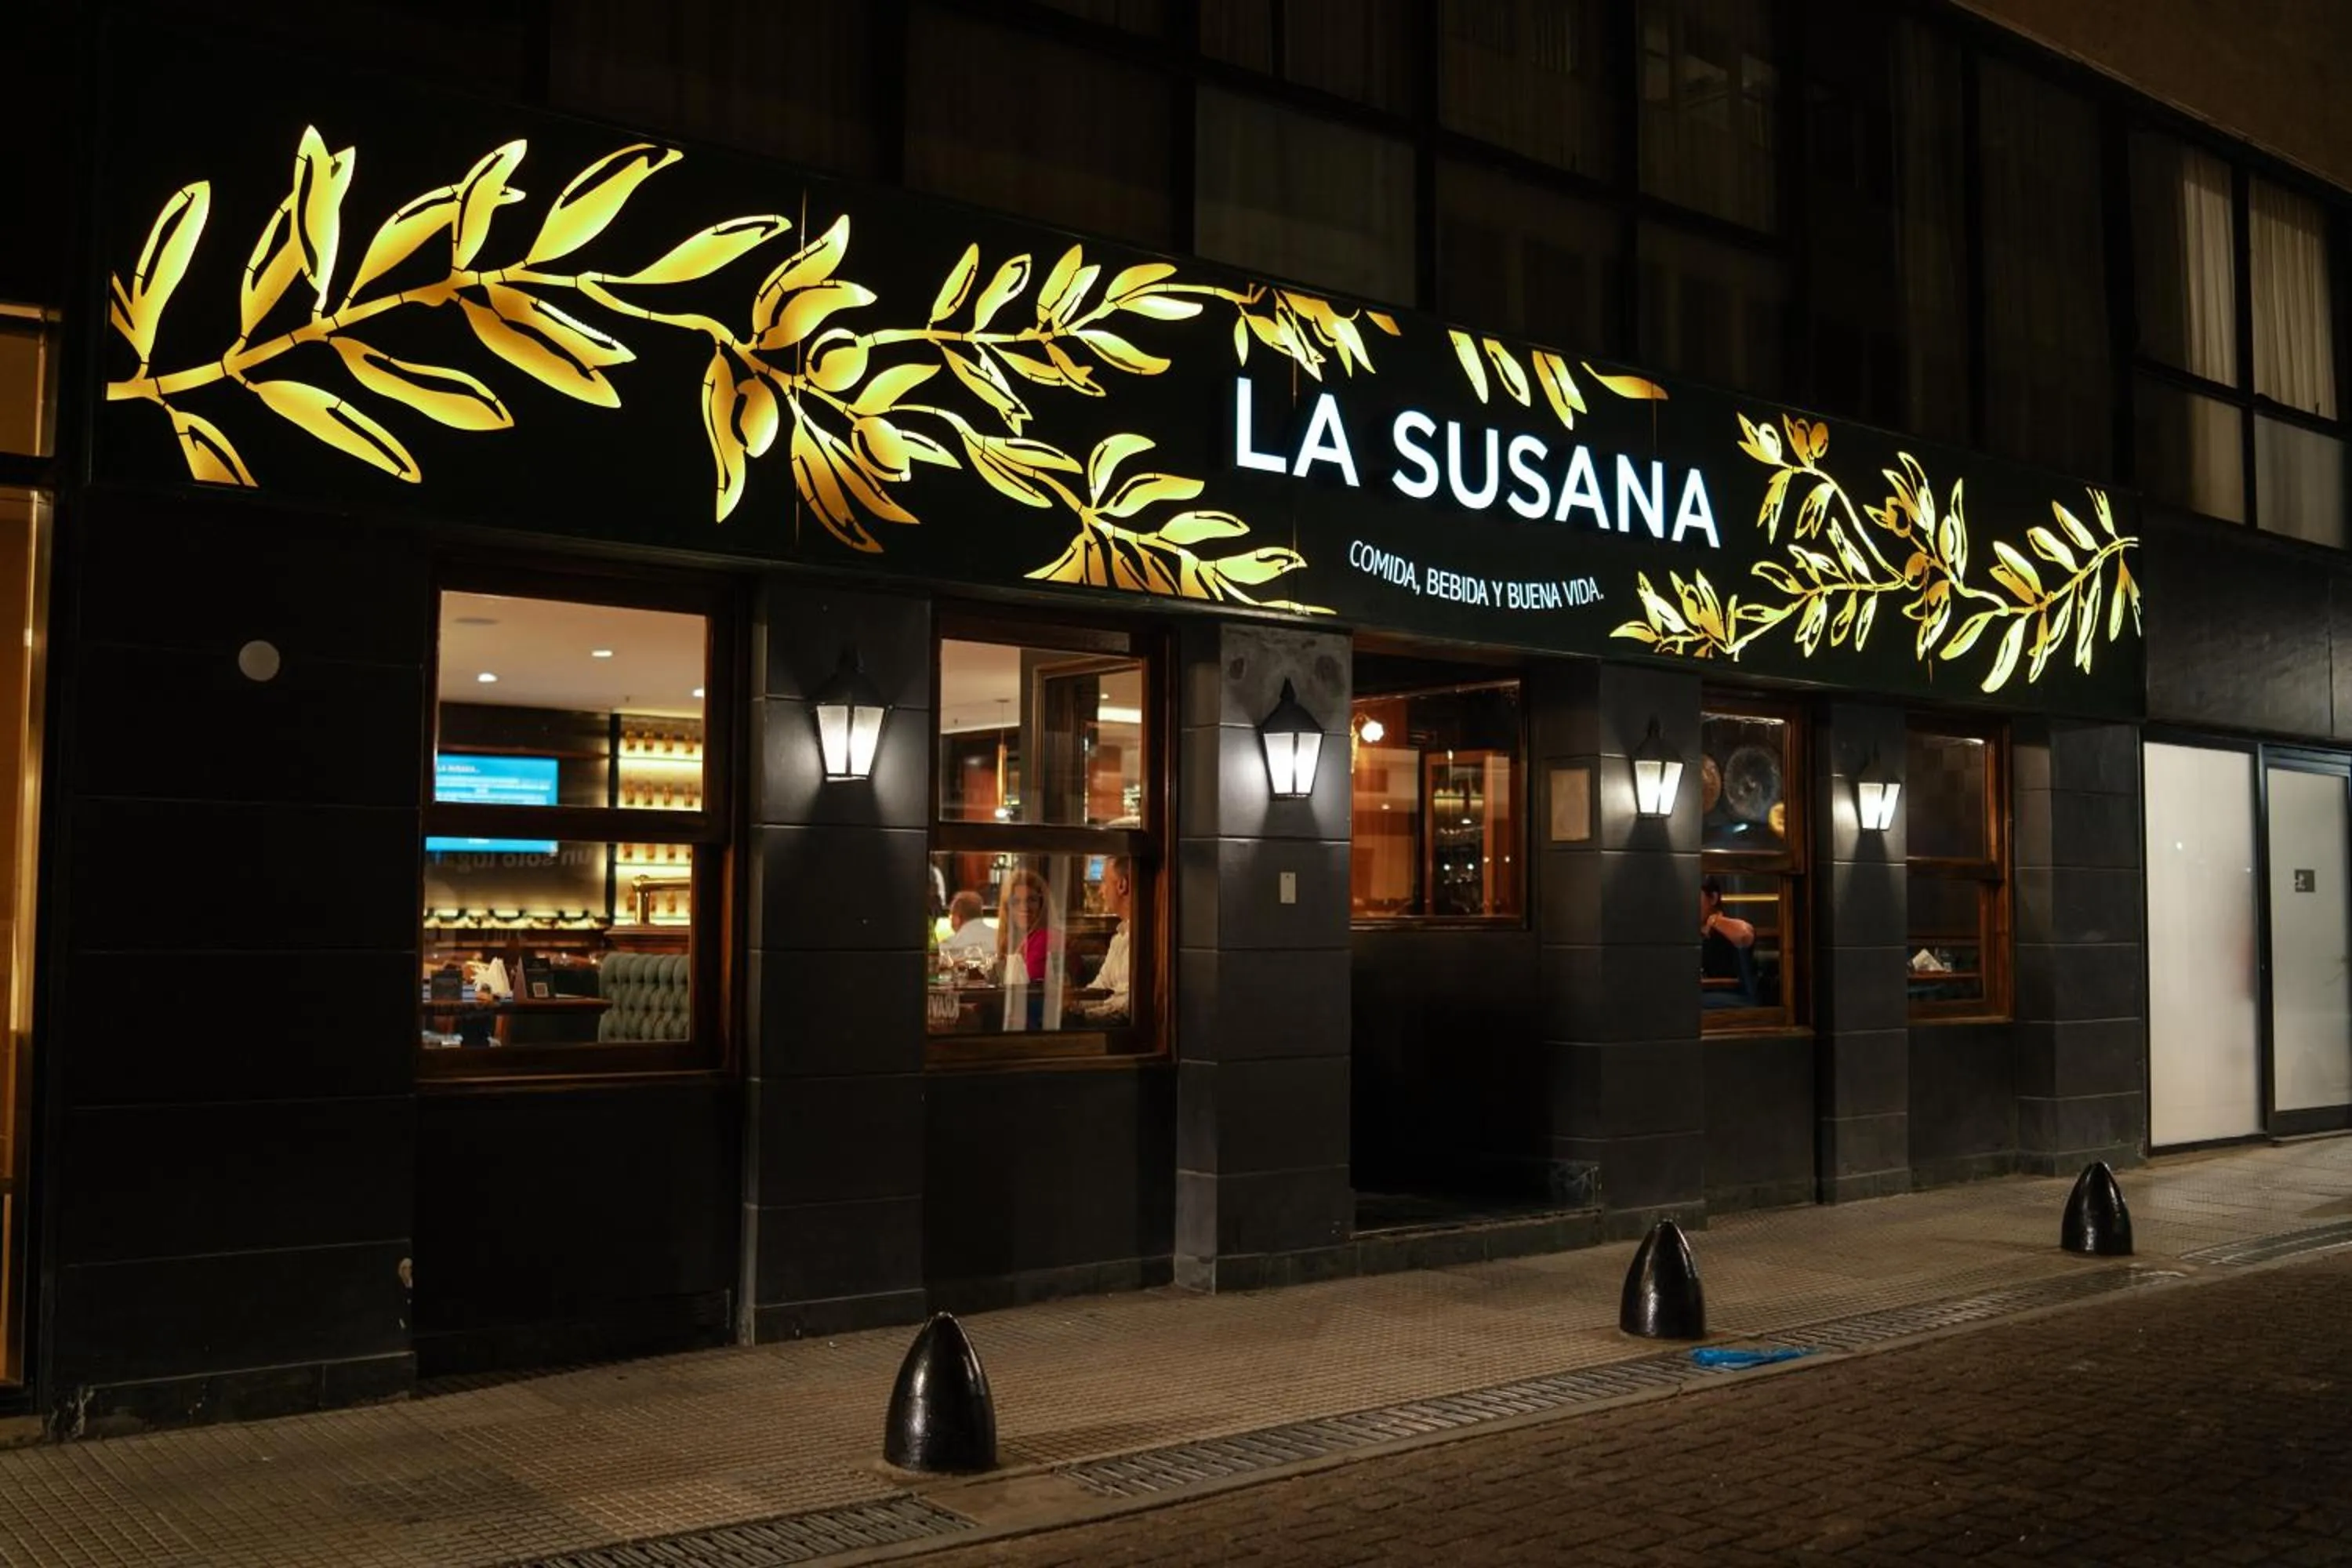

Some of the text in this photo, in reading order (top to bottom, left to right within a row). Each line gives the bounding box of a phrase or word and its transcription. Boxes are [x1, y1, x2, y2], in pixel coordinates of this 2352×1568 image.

[1236, 376, 1721, 549] LA SUSANA
[1349, 539, 1605, 610] COMIDA, BEBIDA Y BUENA VIDA.
